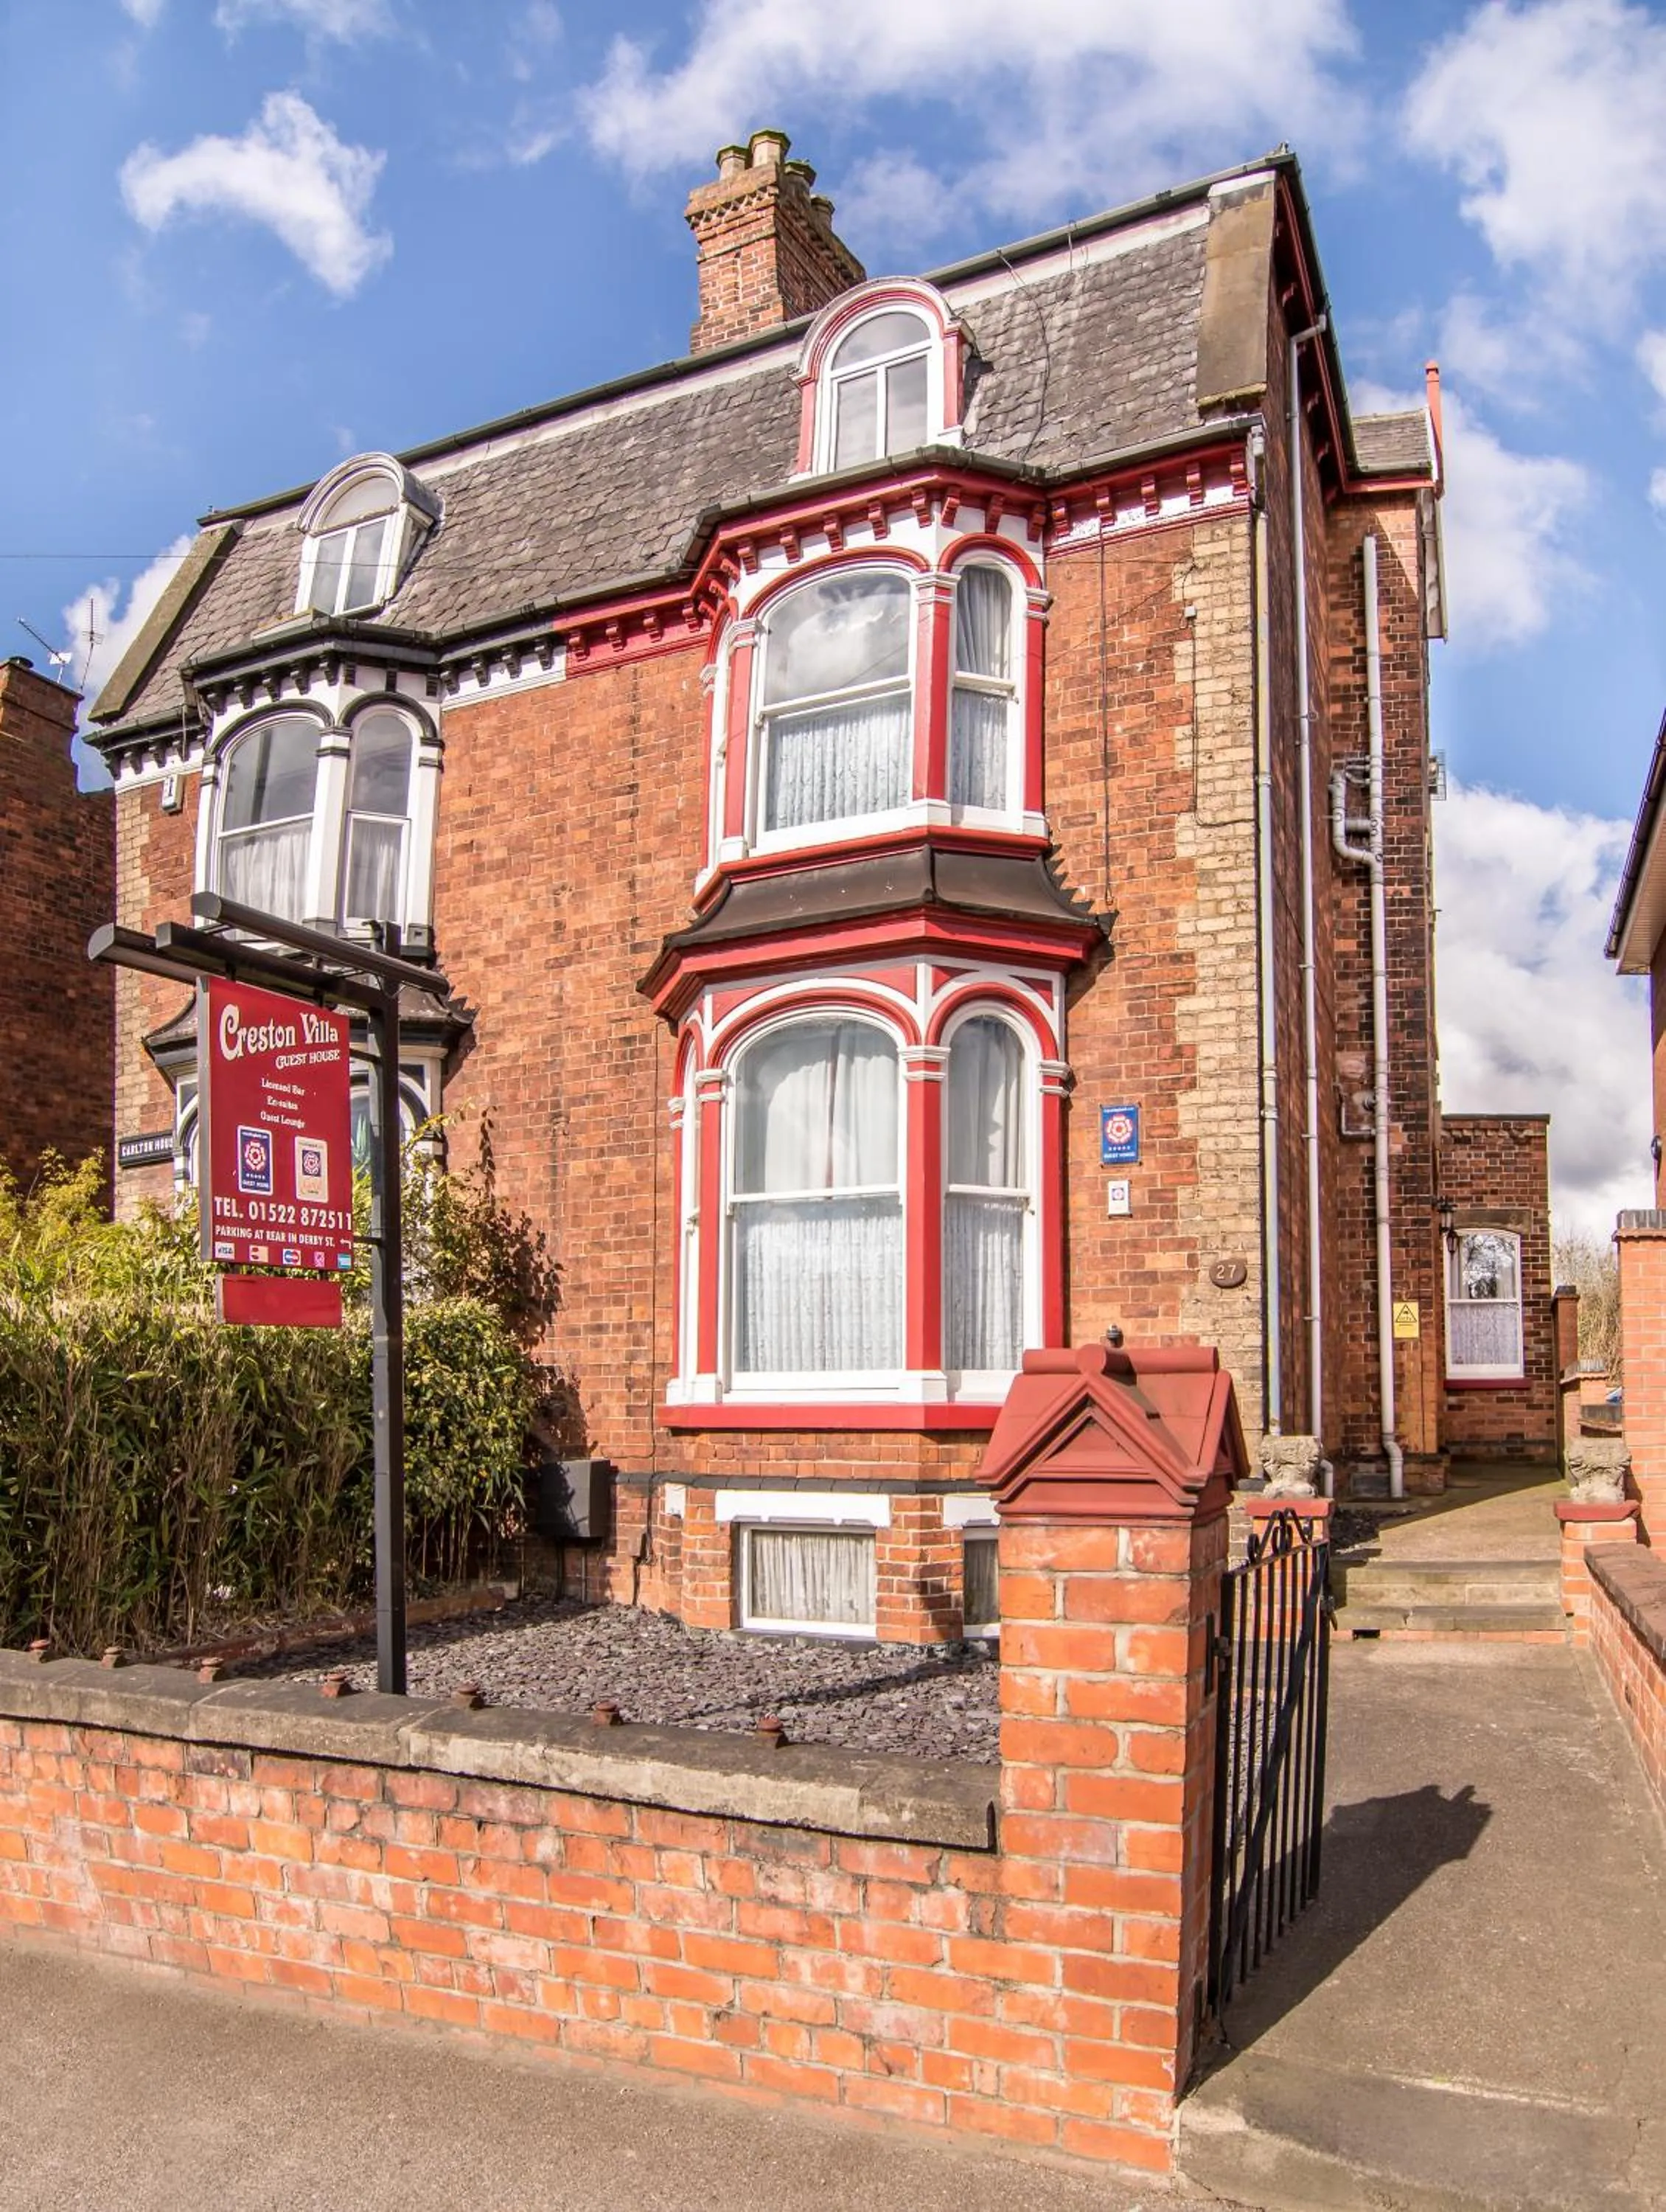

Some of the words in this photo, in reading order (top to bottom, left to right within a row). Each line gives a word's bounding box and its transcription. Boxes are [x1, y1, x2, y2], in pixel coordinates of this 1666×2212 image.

[220, 1004, 296, 1061] Creston
[300, 1012, 338, 1044] Villa
[276, 1053, 307, 1069] GUEST
[310, 1050, 341, 1063] HOUSE
[214, 1196, 244, 1219] TEL.
[248, 1201, 296, 1225] 01522
[300, 1207, 352, 1231] 872511
[215, 1225, 253, 1239] PARKING
[254, 1230, 264, 1240] AT
[266, 1231, 286, 1242] REAR
[288, 1233, 297, 1244] IN
[299, 1234, 324, 1247] DERBY
[325, 1237, 335, 1248] ST.
[1216, 1264, 1237, 1279] 27
